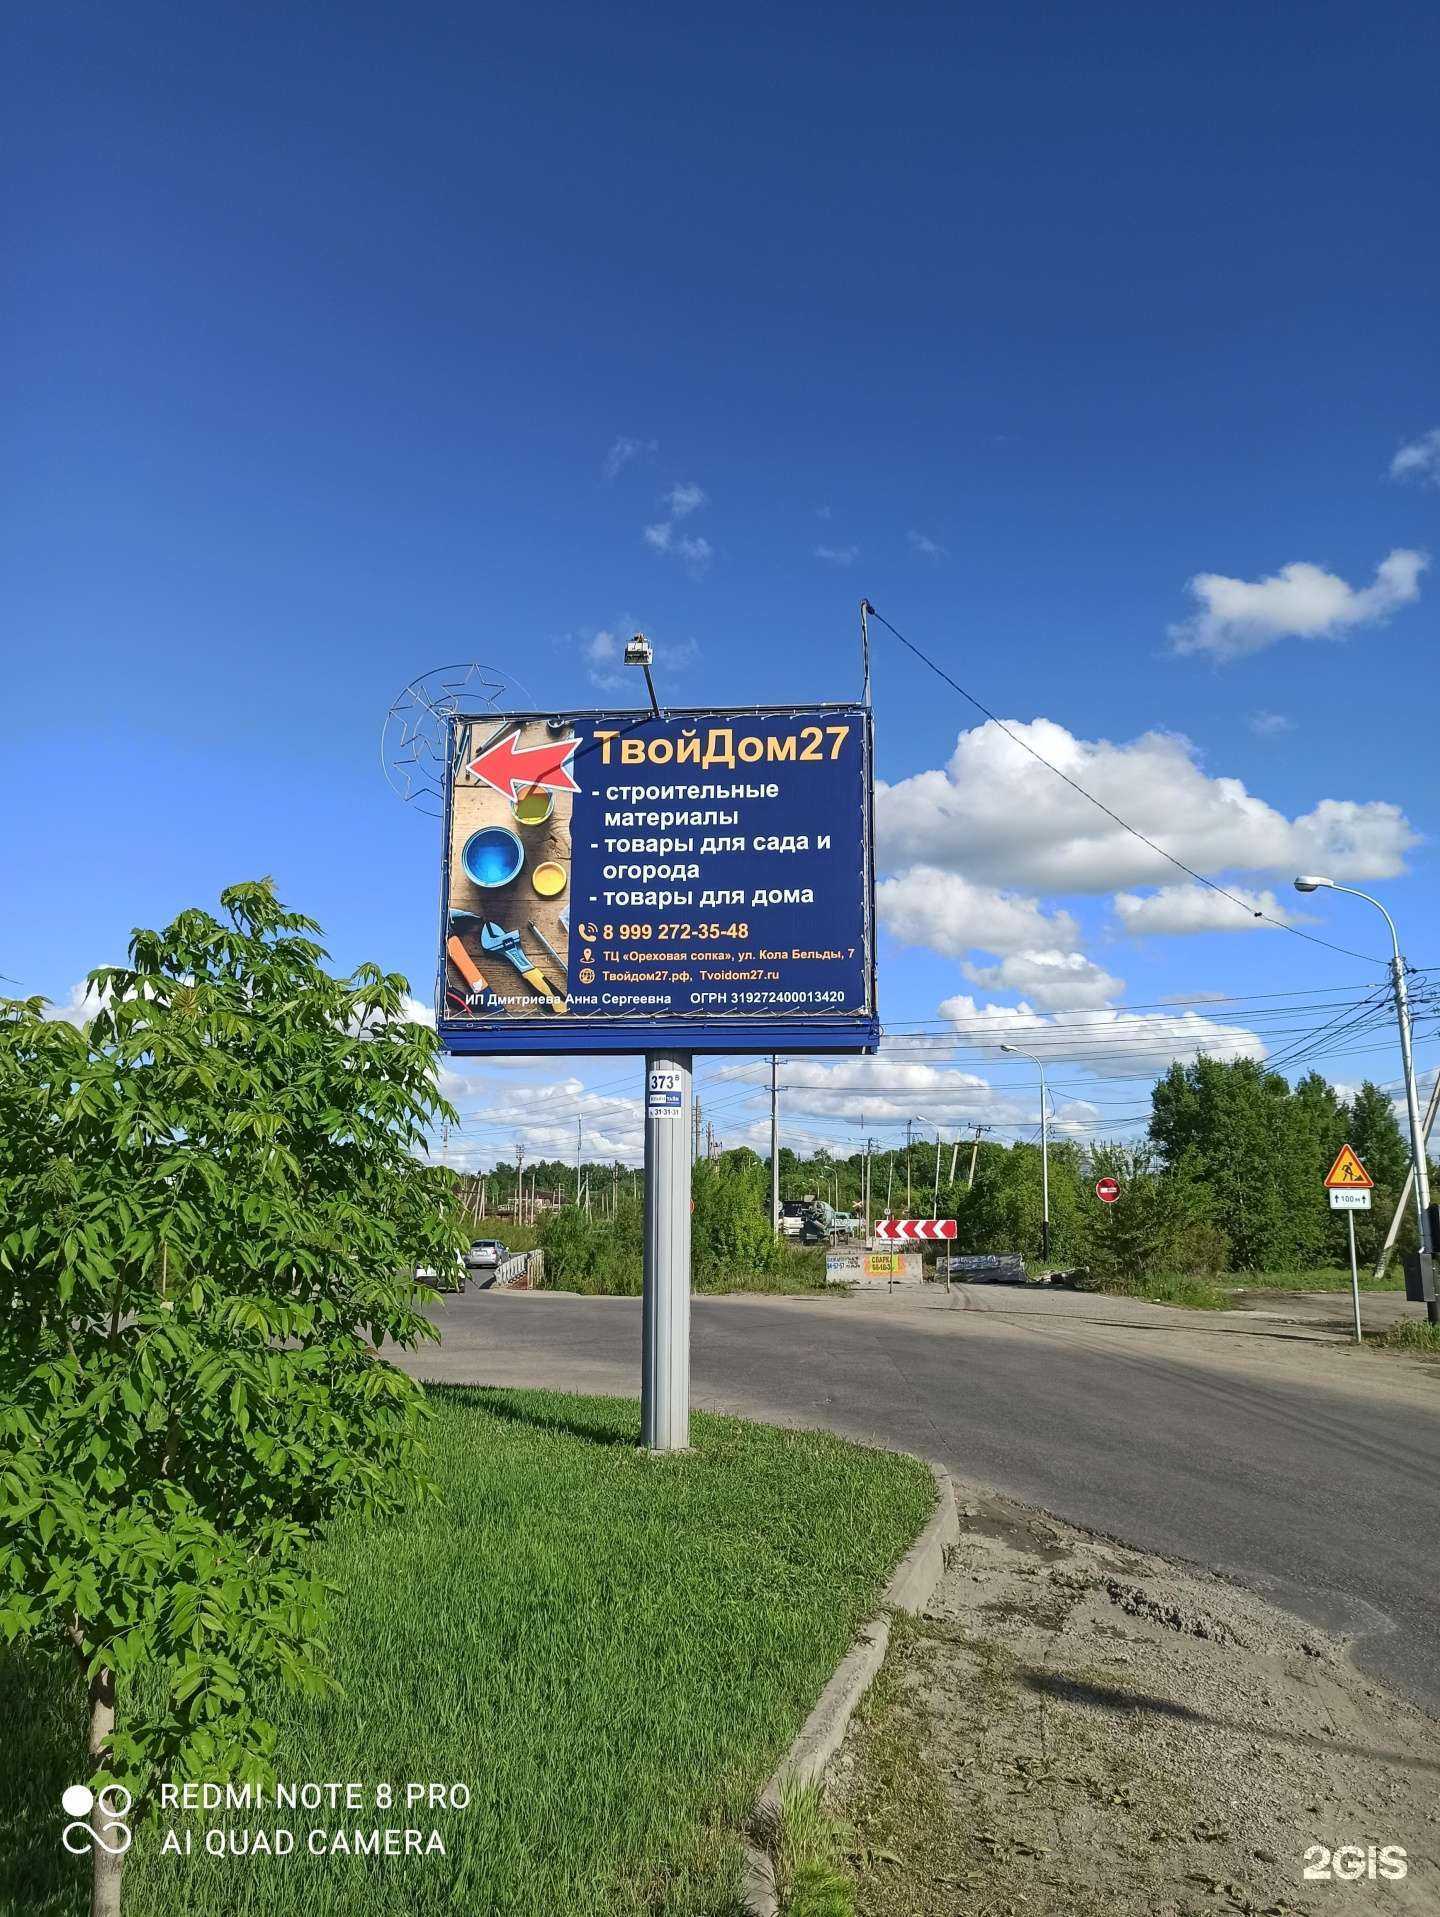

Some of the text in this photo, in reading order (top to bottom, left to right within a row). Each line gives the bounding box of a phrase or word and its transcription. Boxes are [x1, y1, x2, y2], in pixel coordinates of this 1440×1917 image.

[593, 726, 850, 770] ТвойДом27
[606, 783, 779, 804] строительные
[604, 810, 738, 830] материалы
[604, 836, 694, 857] товары
[700, 836, 746, 855] для
[753, 835, 810, 853] сада
[817, 835, 831, 850] и
[603, 863, 700, 883] огорода
[603, 890, 693, 909] товары
[699, 889, 745, 908] для
[751, 888, 815, 906] дома
[603, 923, 749, 940] 8 999 272-35-48
[603, 948, 855, 963] ТЦ «Ореховая сопка», ул. Кола Бельды, 7
[699, 969, 780, 980] Tvoidom27.ru
[465, 991, 845, 1007] ИП Дмитриева Анна Сергеевна ОГРН 319272400013420
[1341, 1195, 1354, 1203] 100
